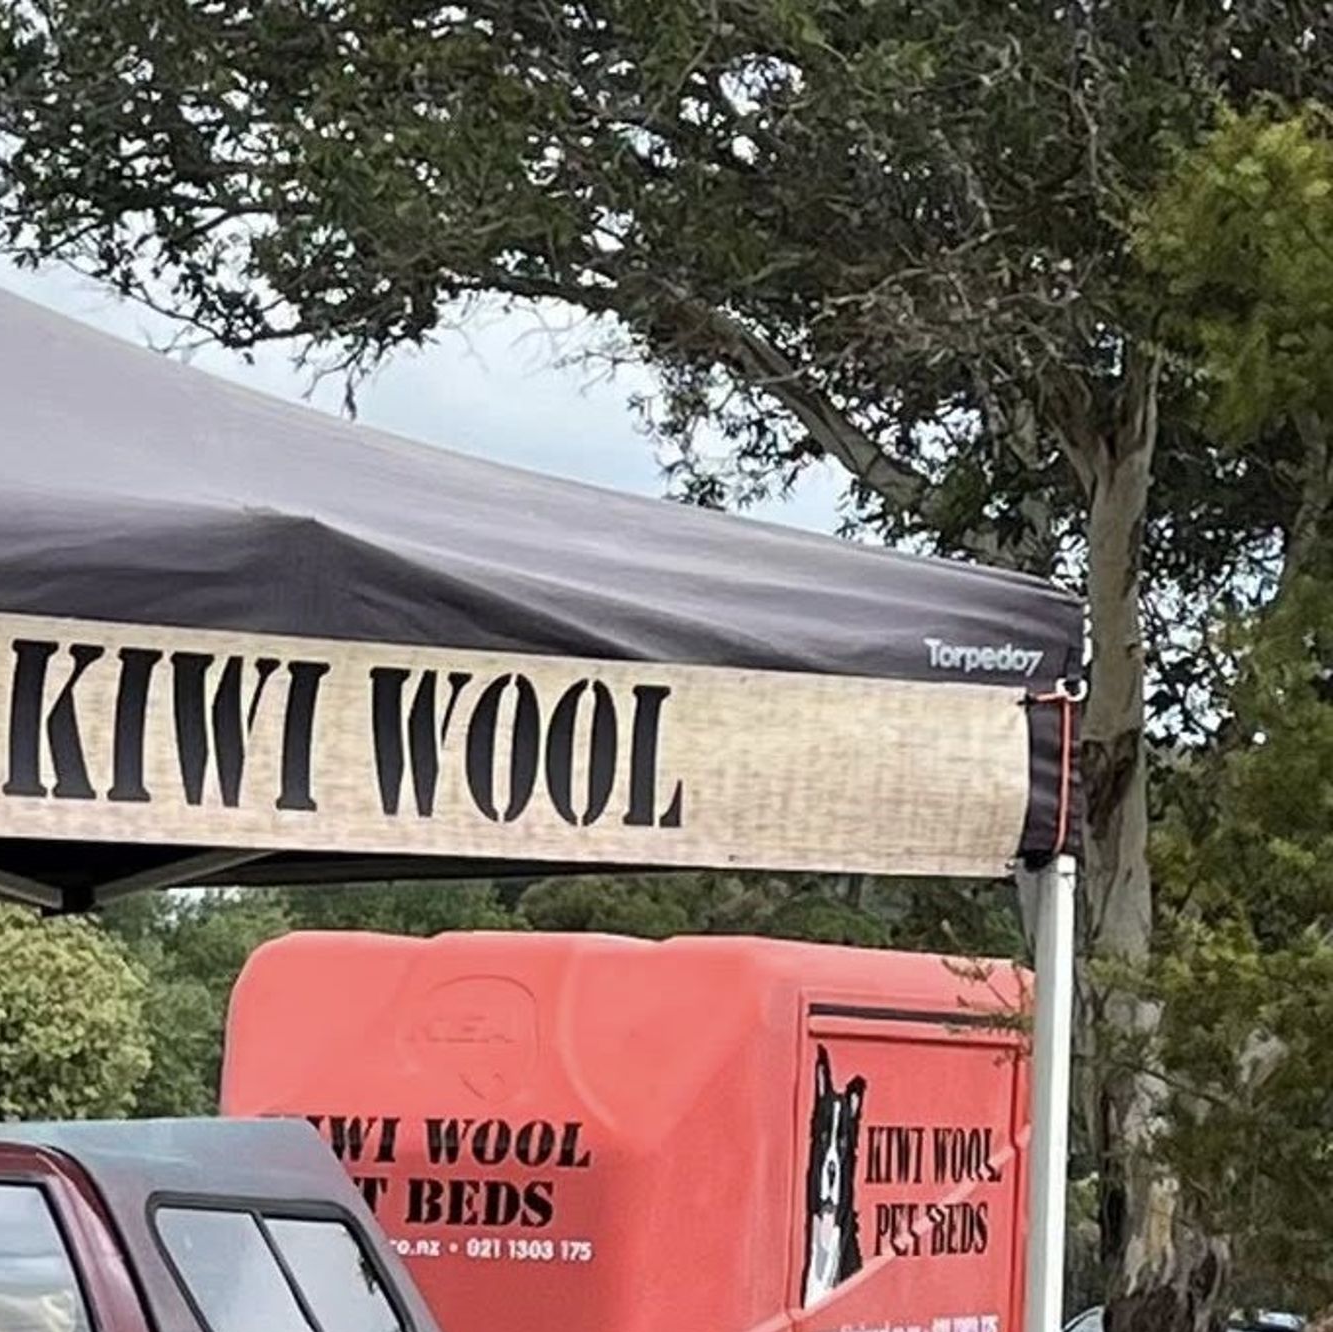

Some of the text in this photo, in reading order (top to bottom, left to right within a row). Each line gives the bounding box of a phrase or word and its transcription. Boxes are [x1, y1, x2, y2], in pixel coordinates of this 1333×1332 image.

[923, 638, 1044, 677] Torpedo7
[3, 639, 683, 829] KIWI WOOL
[293, 1114, 591, 1167] WI WOOL
[864, 1126, 1002, 1184] KIWI WOOL
[404, 1177, 554, 1228] BEDS
[466, 1238, 501, 1259] 021
[508, 1239, 554, 1260] 1303
[560, 1240, 593, 1260] 175
[874, 1202, 989, 1257] PET BEDS
